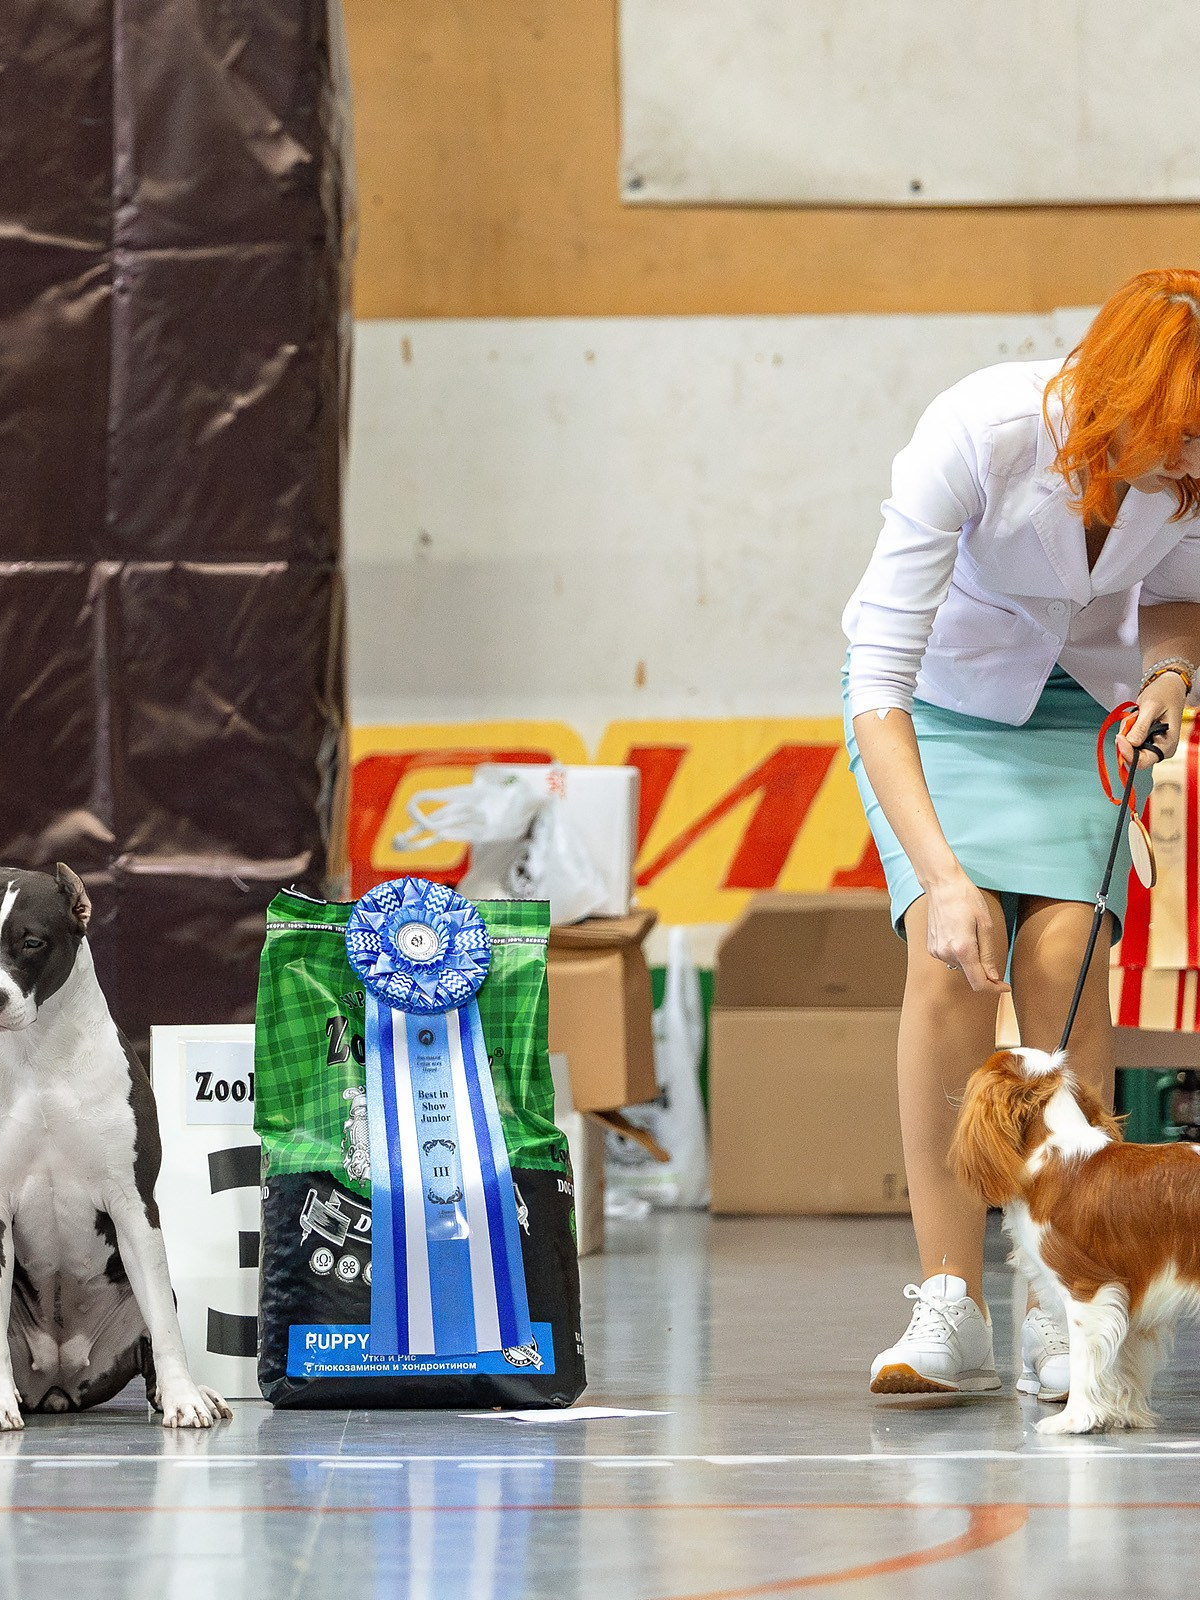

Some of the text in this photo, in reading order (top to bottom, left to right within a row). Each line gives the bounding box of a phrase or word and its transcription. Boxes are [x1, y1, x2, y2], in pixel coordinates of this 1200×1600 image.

[418, 1089, 449, 1099] Best in
[422, 1102, 447, 1112] Show
[420, 1113, 451, 1123] Junior
[433, 1166, 449, 1178] III
[304, 1332, 371, 1350] PUPPY
[314, 1363, 391, 1372] глюкозамином
[401, 1362, 477, 1372] хондроитином
